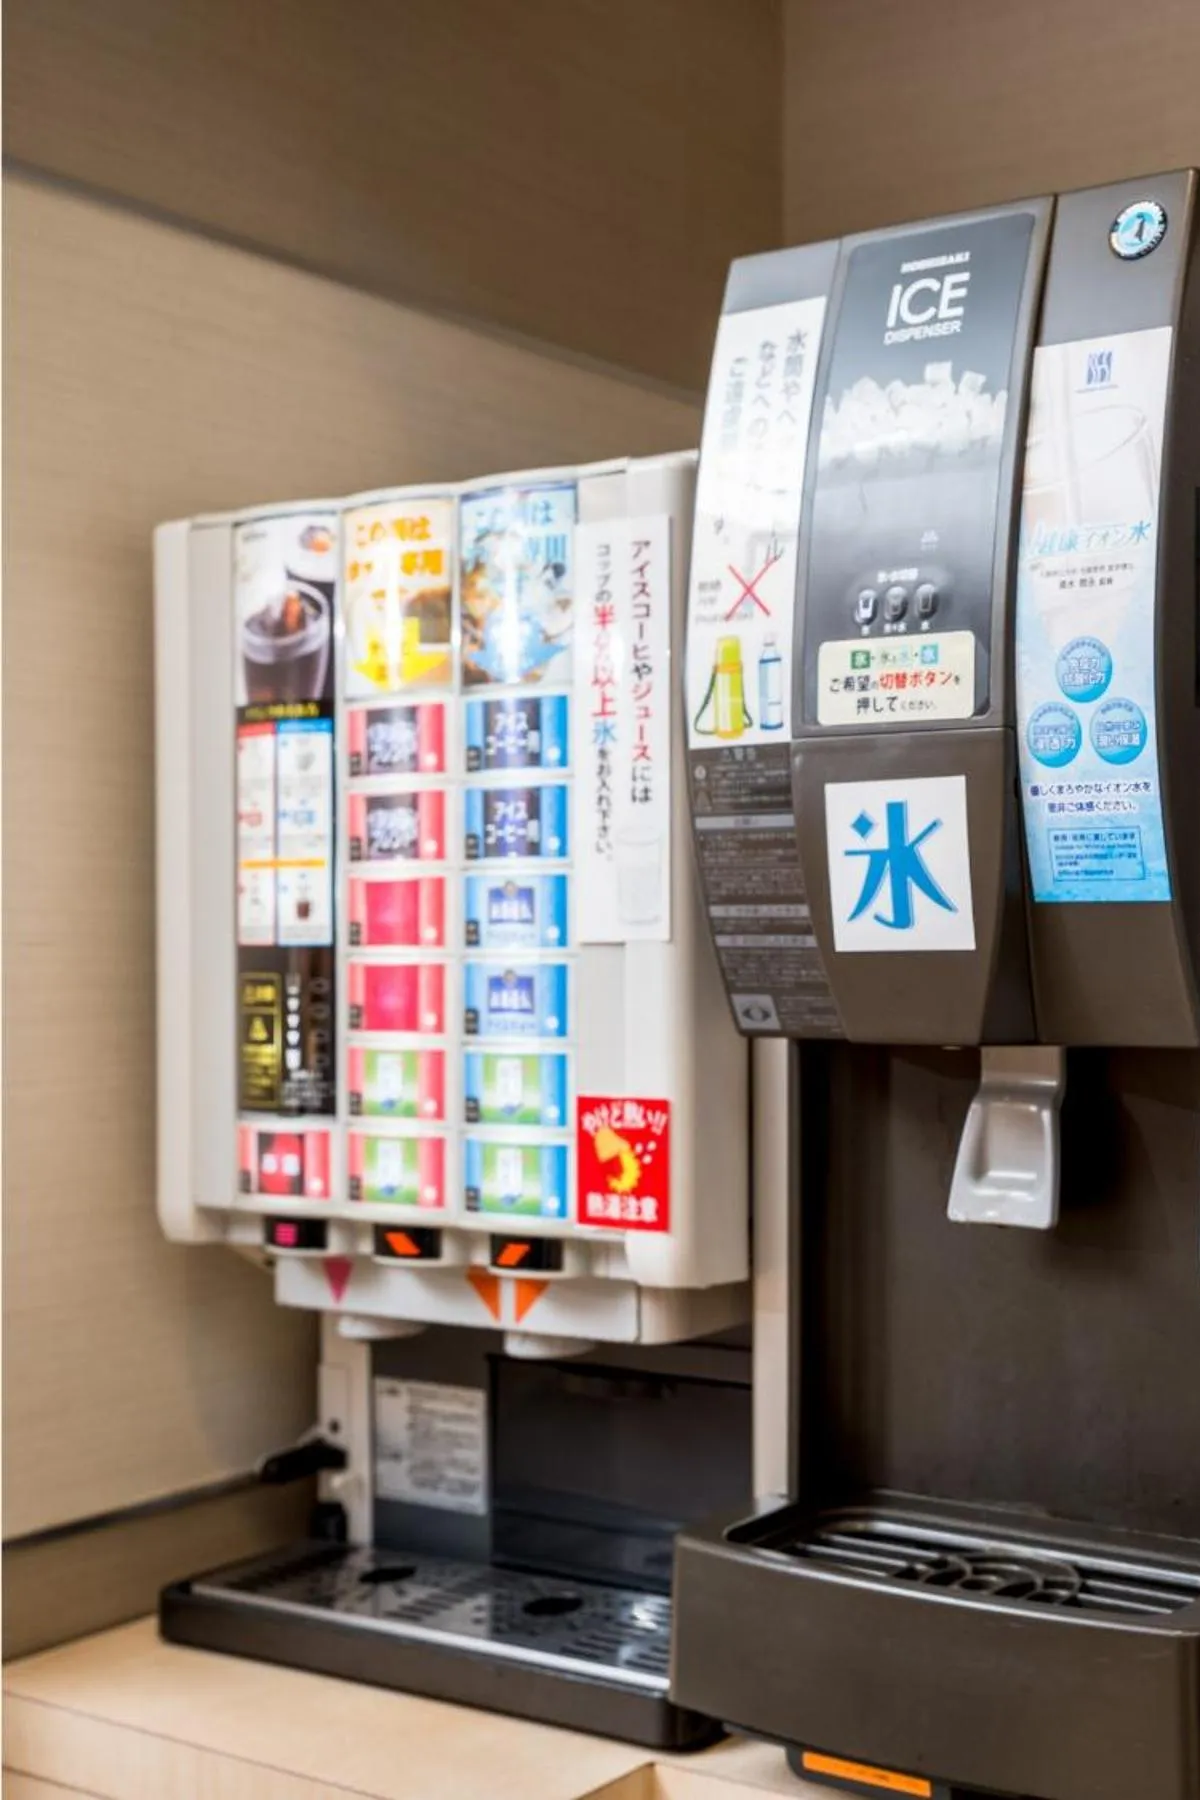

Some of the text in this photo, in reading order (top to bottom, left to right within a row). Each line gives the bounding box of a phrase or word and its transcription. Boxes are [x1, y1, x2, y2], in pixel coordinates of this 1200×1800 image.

[886, 272, 971, 328] ICE
[883, 320, 962, 345] DISPENSER
[844, 799, 959, 930] 氷
